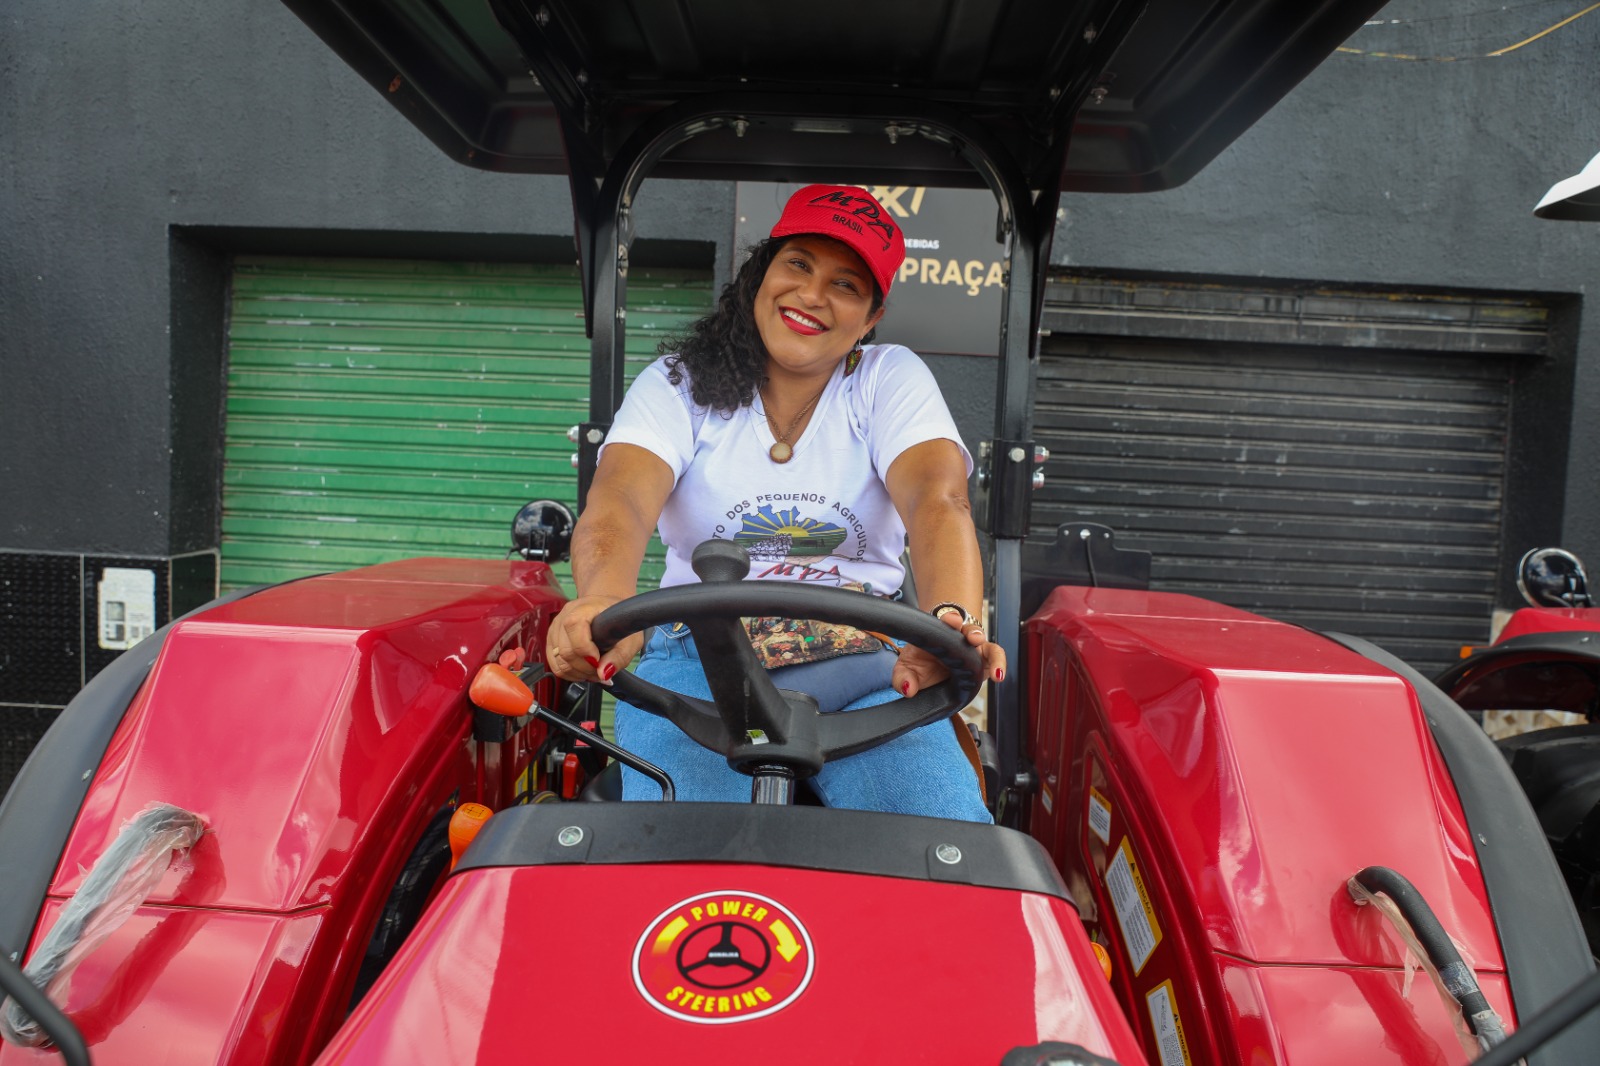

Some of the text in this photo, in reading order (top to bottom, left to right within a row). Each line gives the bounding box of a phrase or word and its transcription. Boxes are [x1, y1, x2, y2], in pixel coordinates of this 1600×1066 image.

[832, 213, 864, 236] BRASIL
[899, 257, 1005, 297] PRAÇA
[725, 500, 751, 520] DOS
[756, 492, 827, 505] PEQUENOS
[690, 900, 769, 922] POWER
[665, 985, 773, 1013] STEERING
